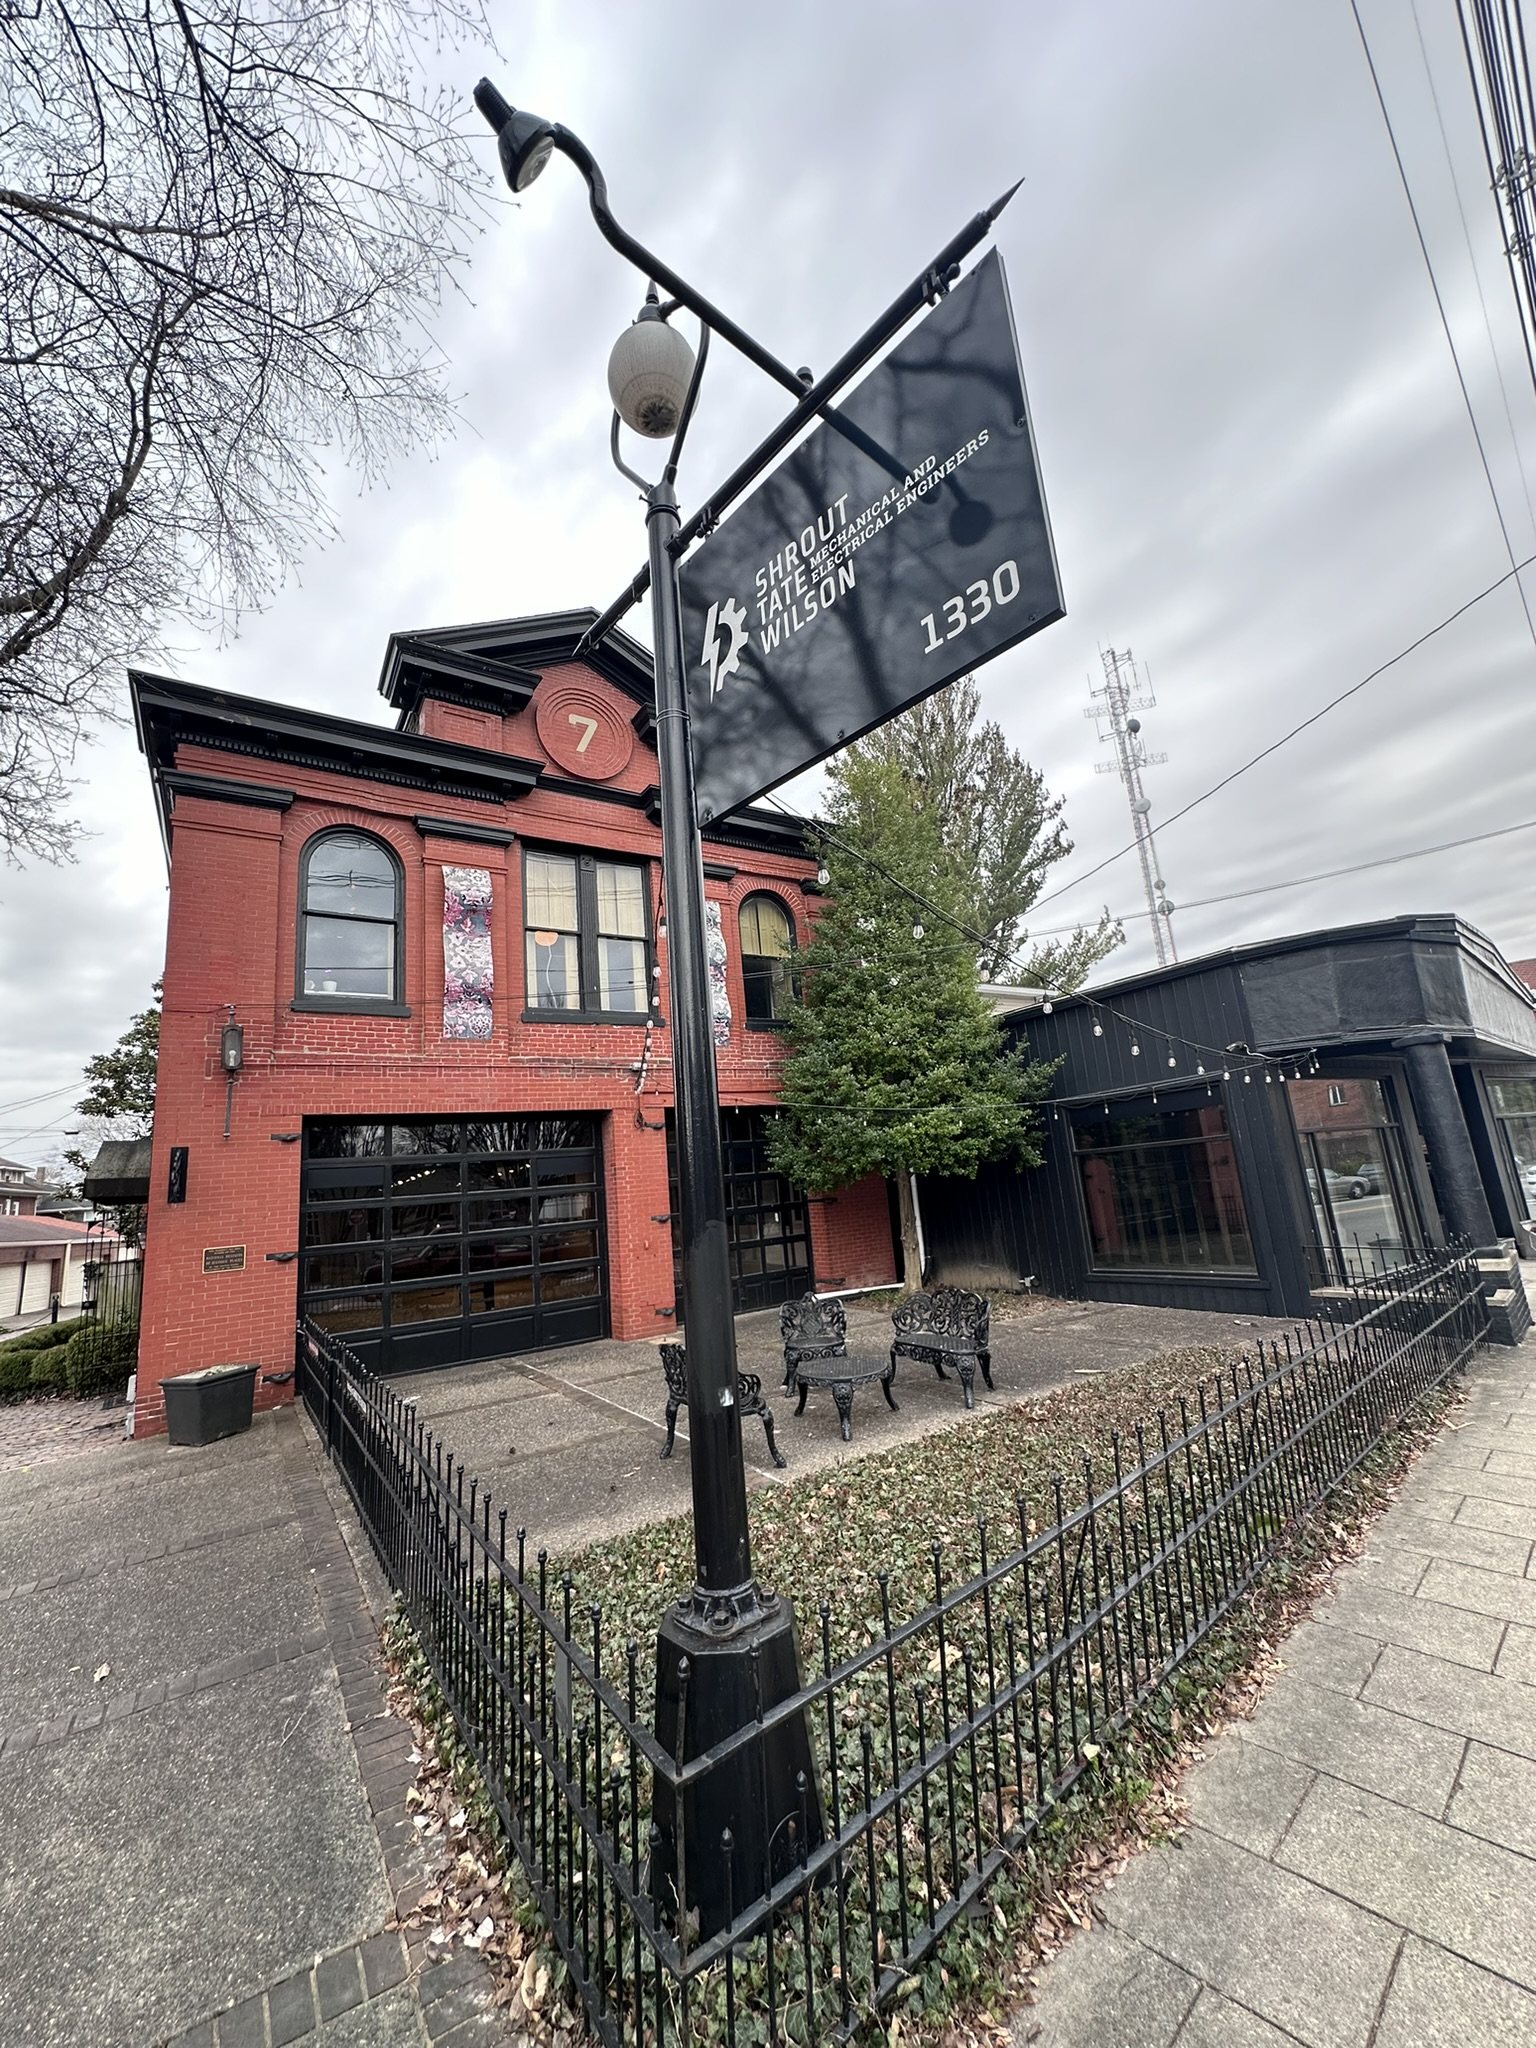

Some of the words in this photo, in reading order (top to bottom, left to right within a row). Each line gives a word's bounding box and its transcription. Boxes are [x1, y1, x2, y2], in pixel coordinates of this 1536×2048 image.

[755, 494, 848, 598] SHROUT
[810, 489, 900, 567] MECHANICAL
[903, 455, 936, 491] AND
[811, 511, 894, 584] ELECTRICAL
[896, 429, 989, 515] ENGINEERS
[756, 565, 806, 625] TATE
[759, 560, 856, 655] WILSON
[920, 560, 1020, 654] 1330
[568, 713, 598, 753] 7
